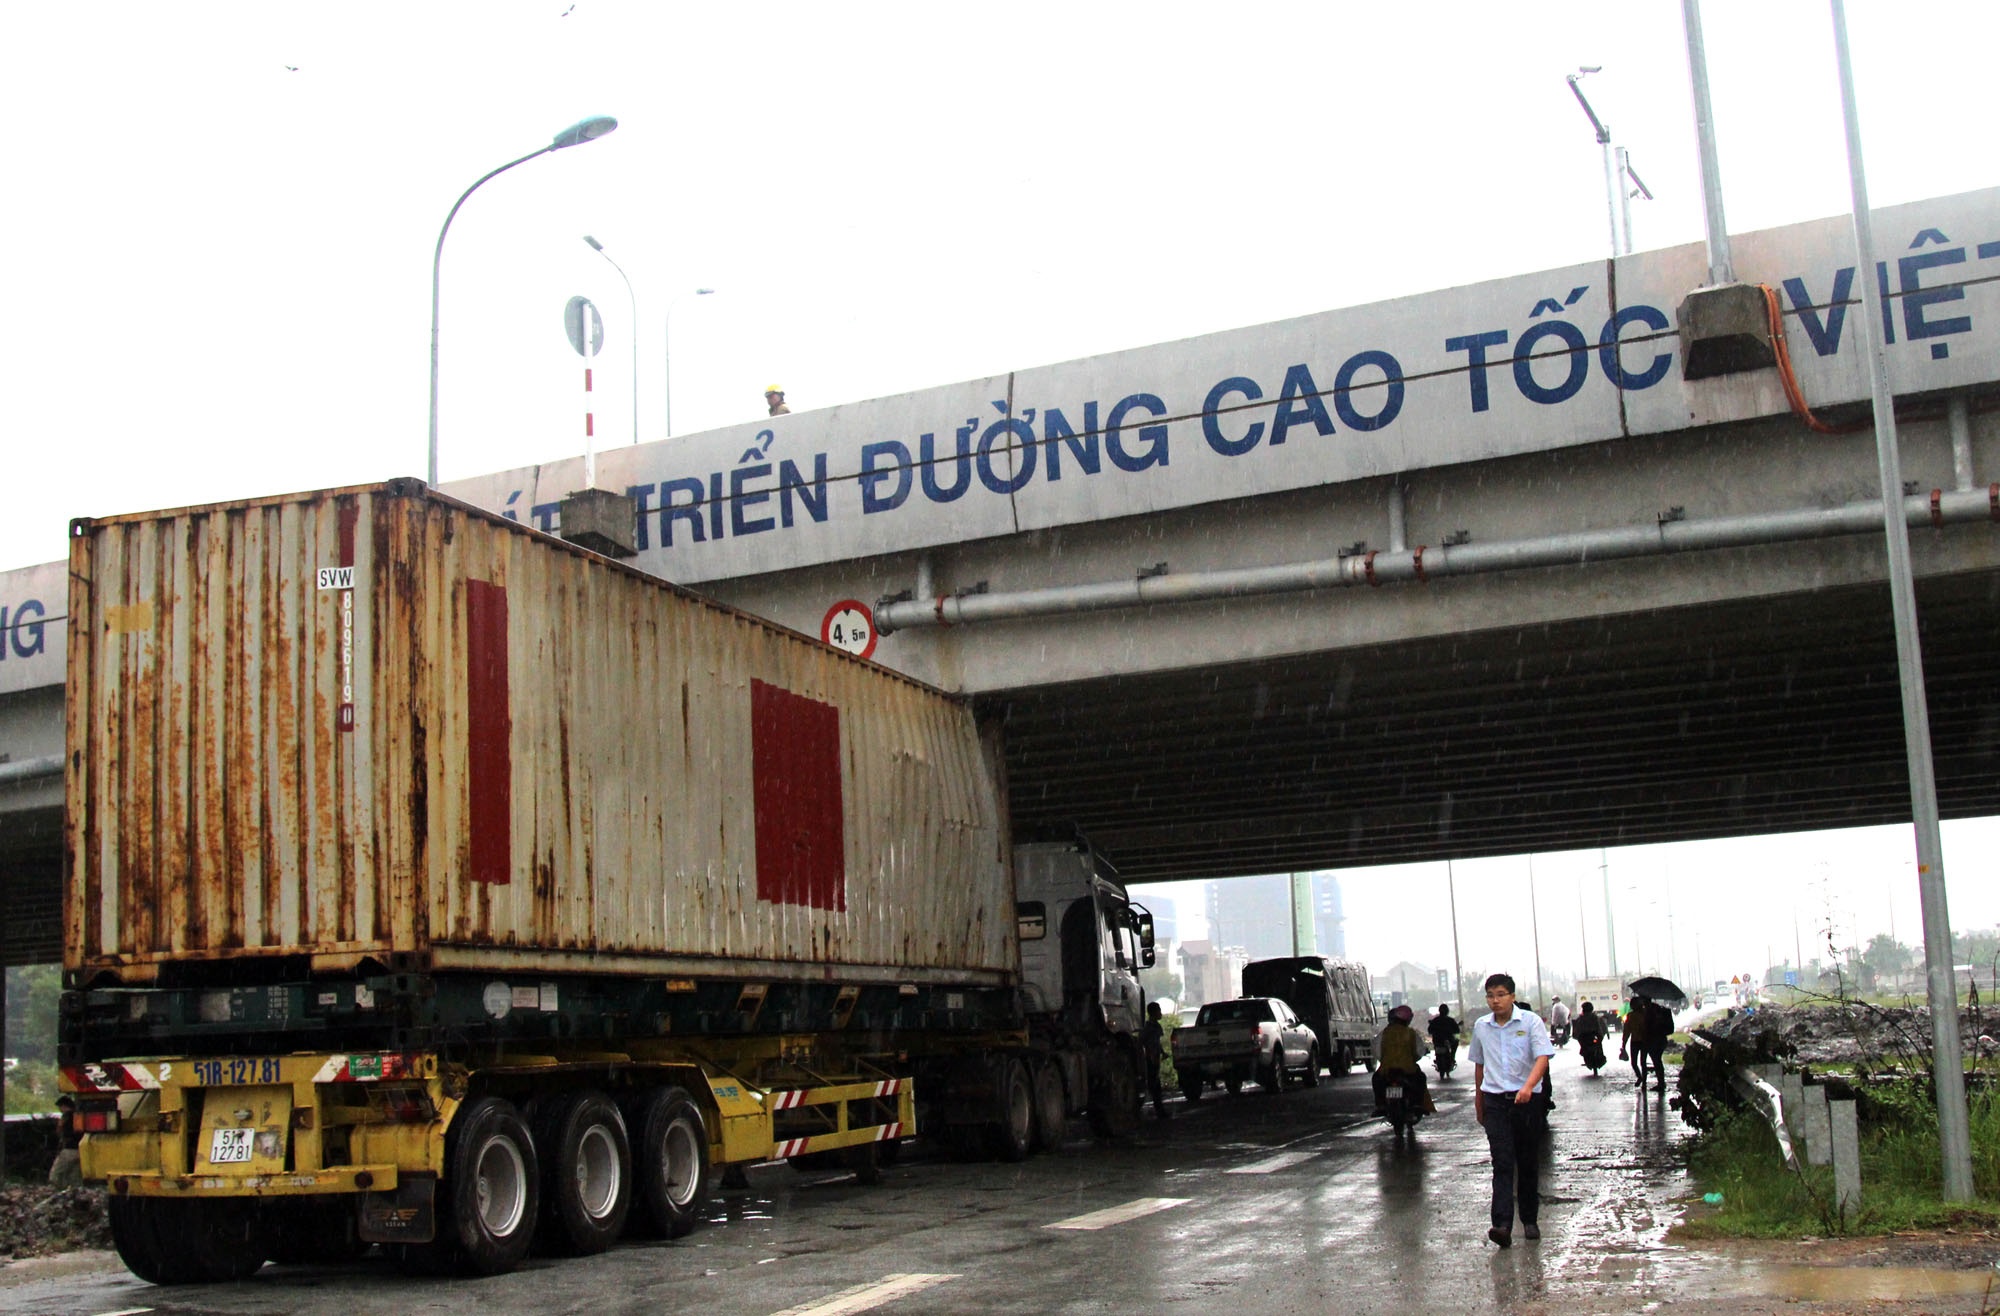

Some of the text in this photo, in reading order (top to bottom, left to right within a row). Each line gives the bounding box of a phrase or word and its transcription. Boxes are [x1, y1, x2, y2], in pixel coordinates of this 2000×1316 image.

[857, 393, 1170, 514] ĐƯỜNG
[1201, 350, 1406, 457] CAO
[1445, 286, 1674, 413] TỐC
[1782, 228, 2000, 360] VIỆ
[320, 570, 352, 587] SVW
[194, 1059, 281, 1085] 51R-127.81
